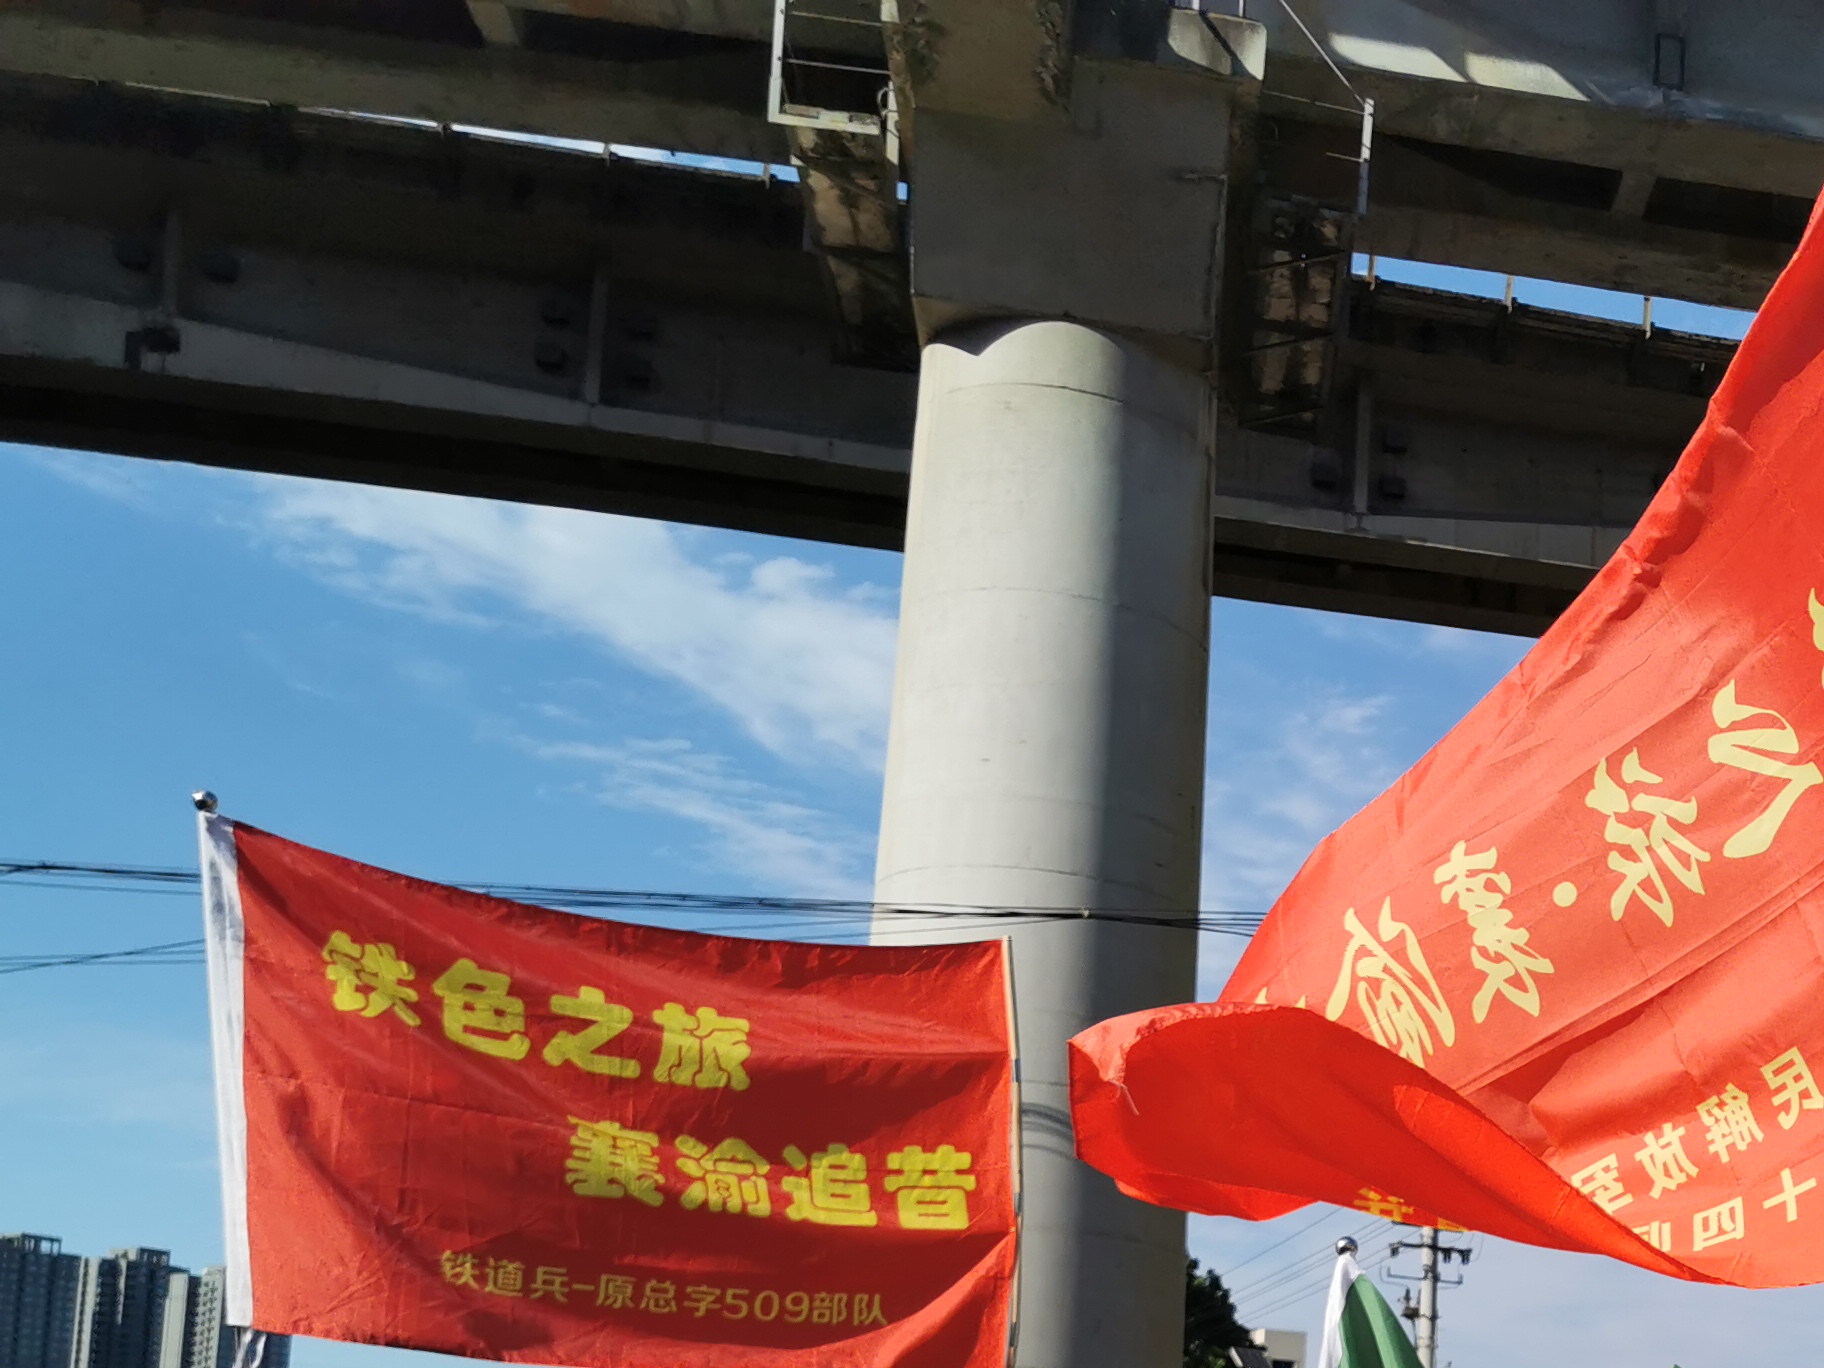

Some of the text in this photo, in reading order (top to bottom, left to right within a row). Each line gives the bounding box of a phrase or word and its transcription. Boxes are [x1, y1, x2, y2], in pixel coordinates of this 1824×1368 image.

[320, 929, 752, 1092] 铁色之旅
[564, 1114, 978, 1232] 襄渝追昔
